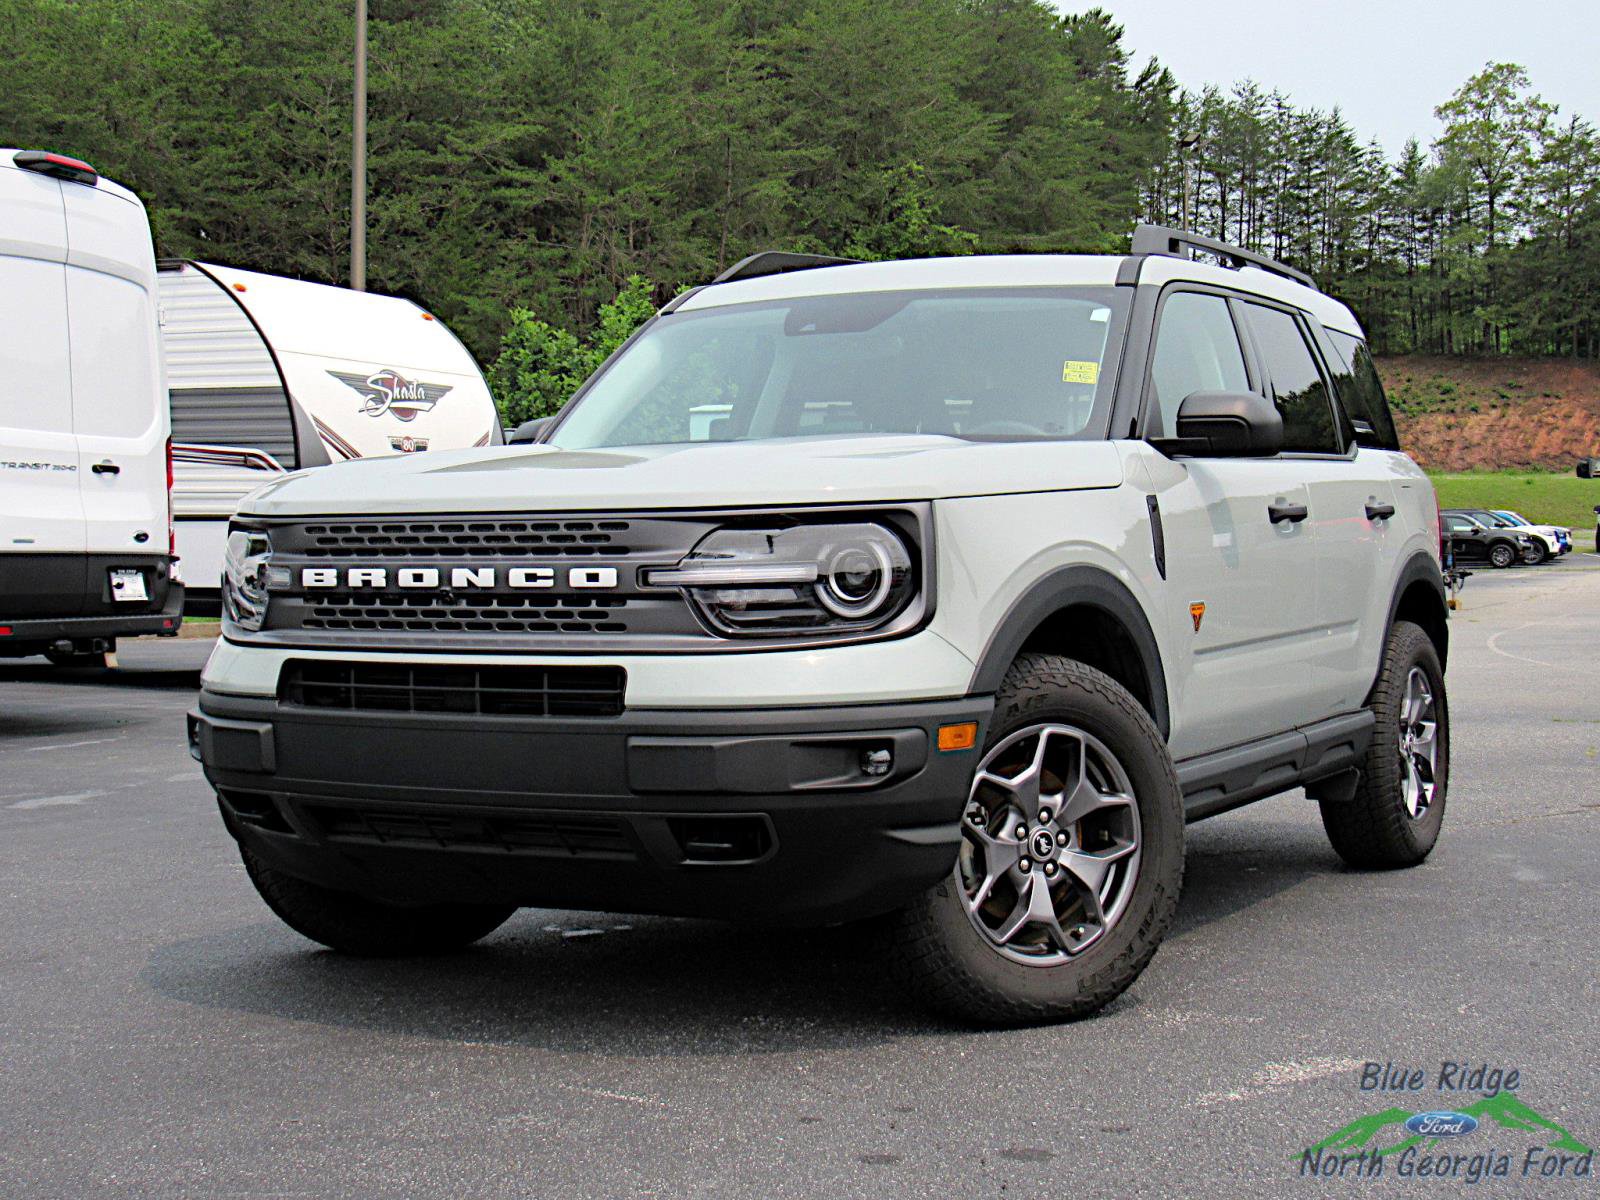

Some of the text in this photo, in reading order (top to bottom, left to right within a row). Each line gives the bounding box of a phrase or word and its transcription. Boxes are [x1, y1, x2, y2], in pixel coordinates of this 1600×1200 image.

[359, 372, 426, 418] Shasta
[1, 462, 50, 471] TRANSIT
[302, 567, 617, 588] BRONCO
